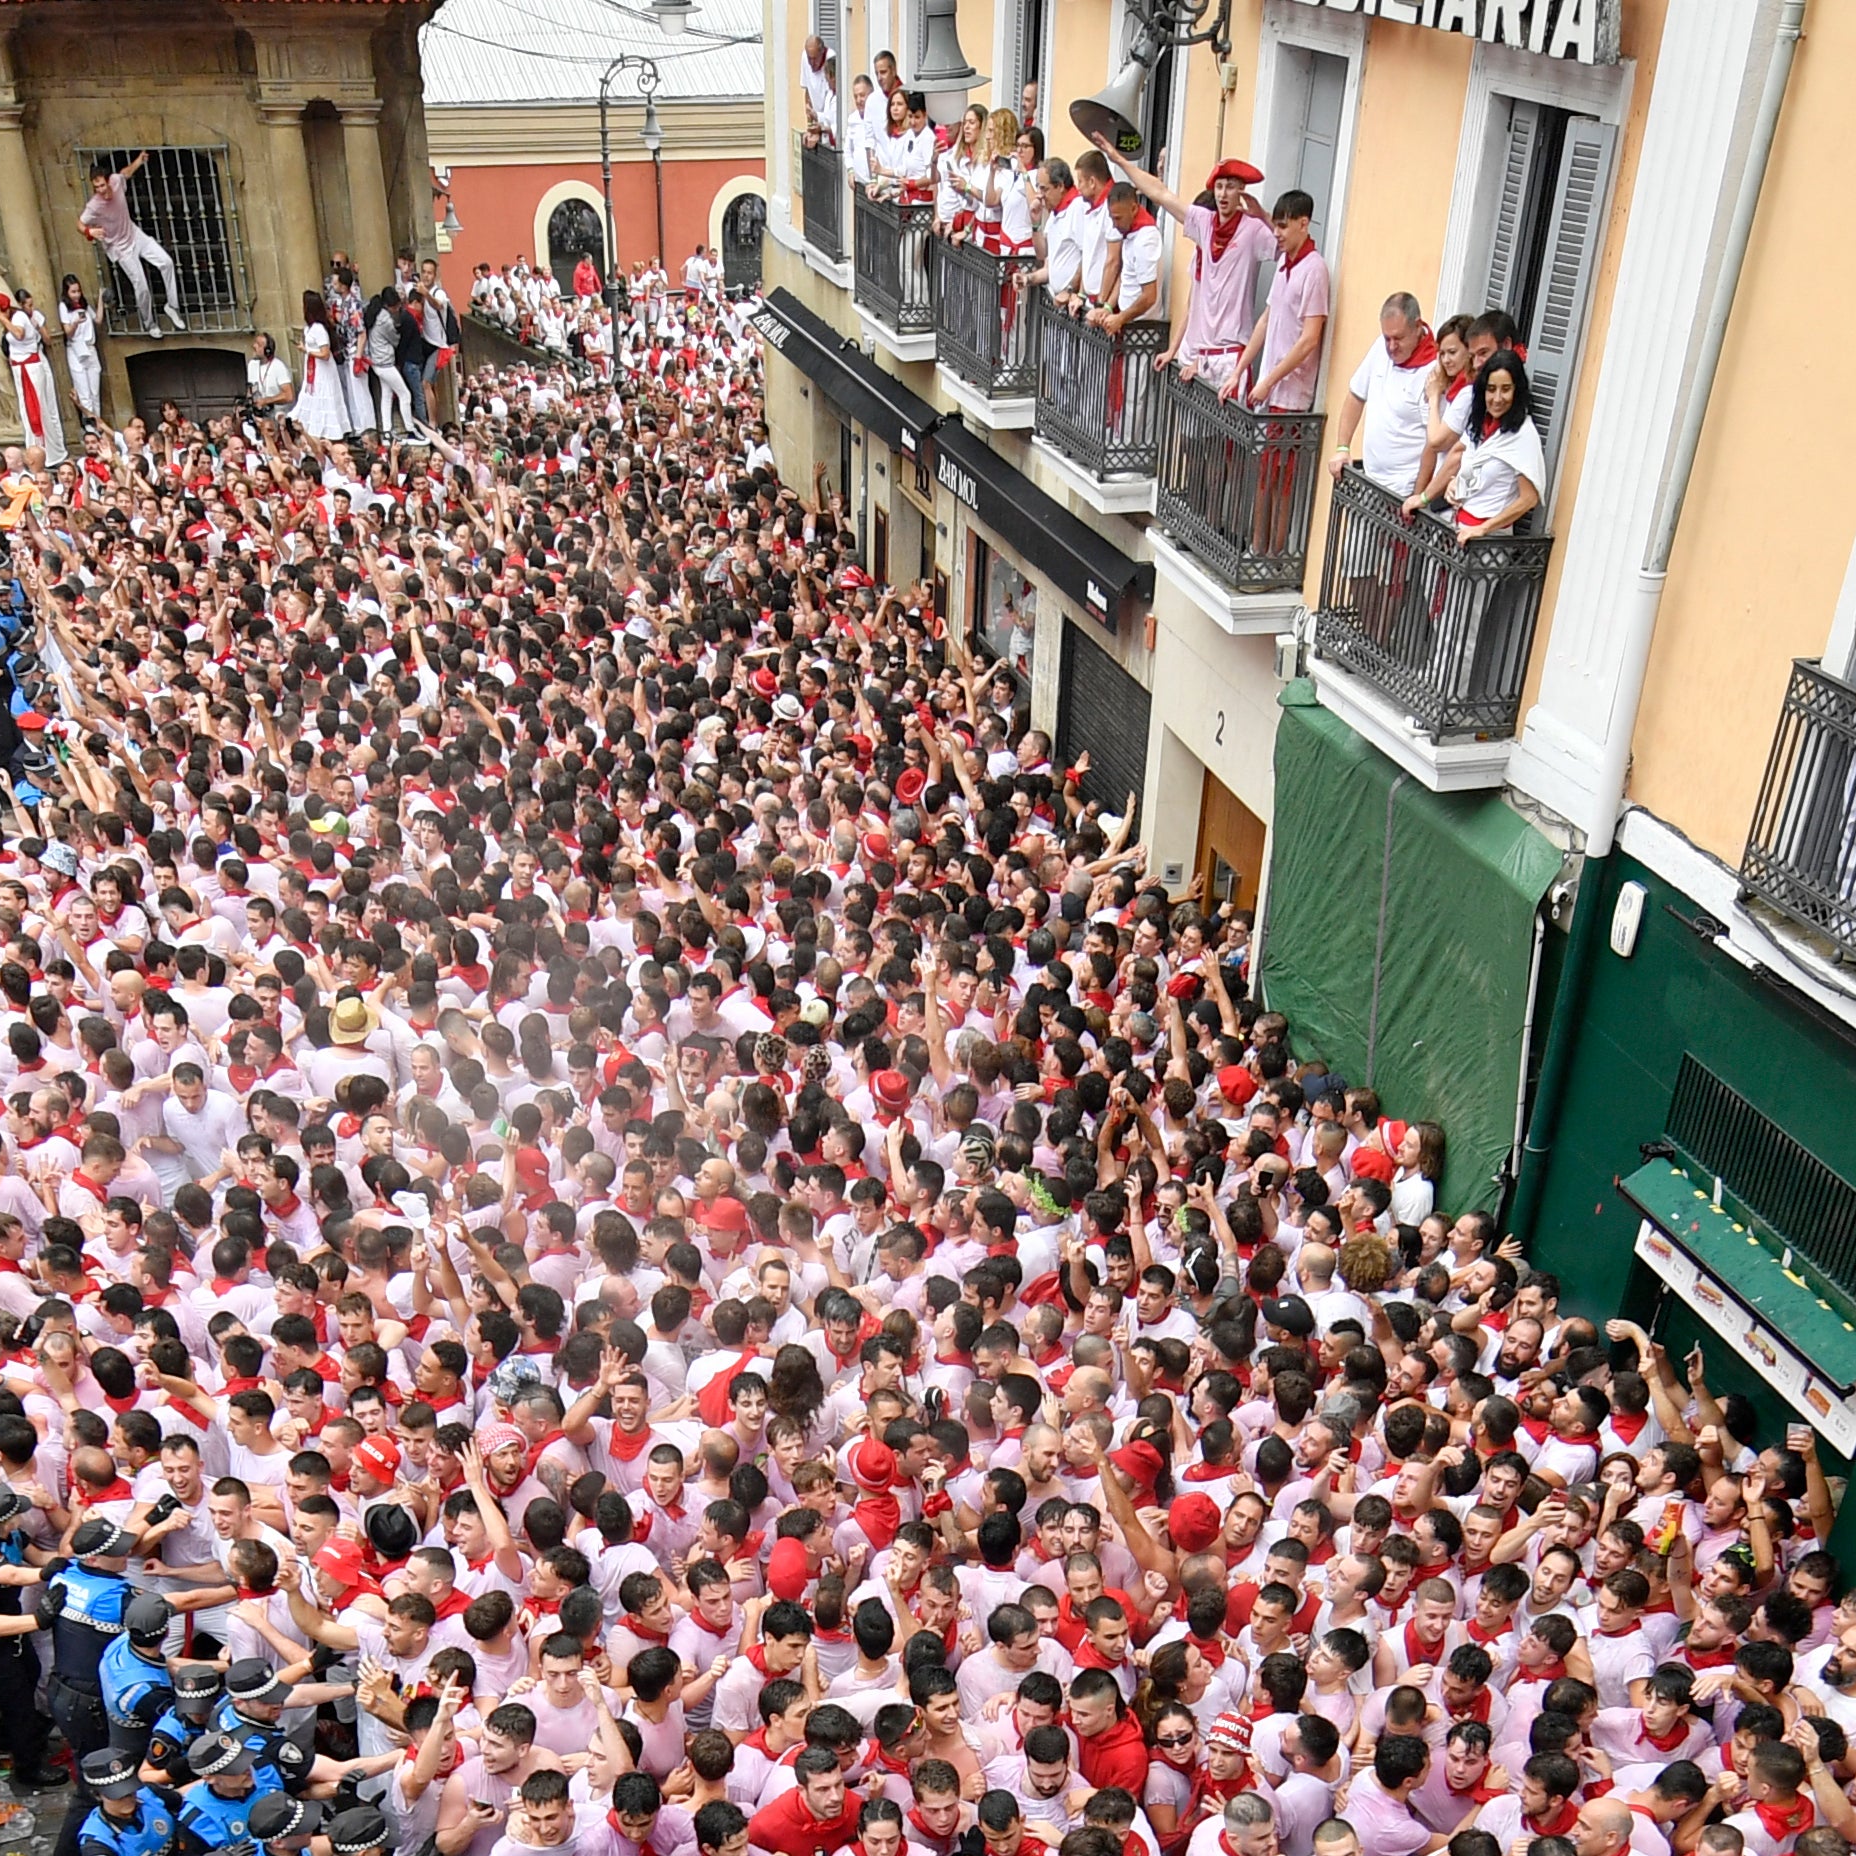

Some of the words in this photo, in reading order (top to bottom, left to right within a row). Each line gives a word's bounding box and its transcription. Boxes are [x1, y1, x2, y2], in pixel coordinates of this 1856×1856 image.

[938, 454, 958, 493] BAR
[957, 472, 979, 511] MOL
[1216, 711, 1225, 747] 2
